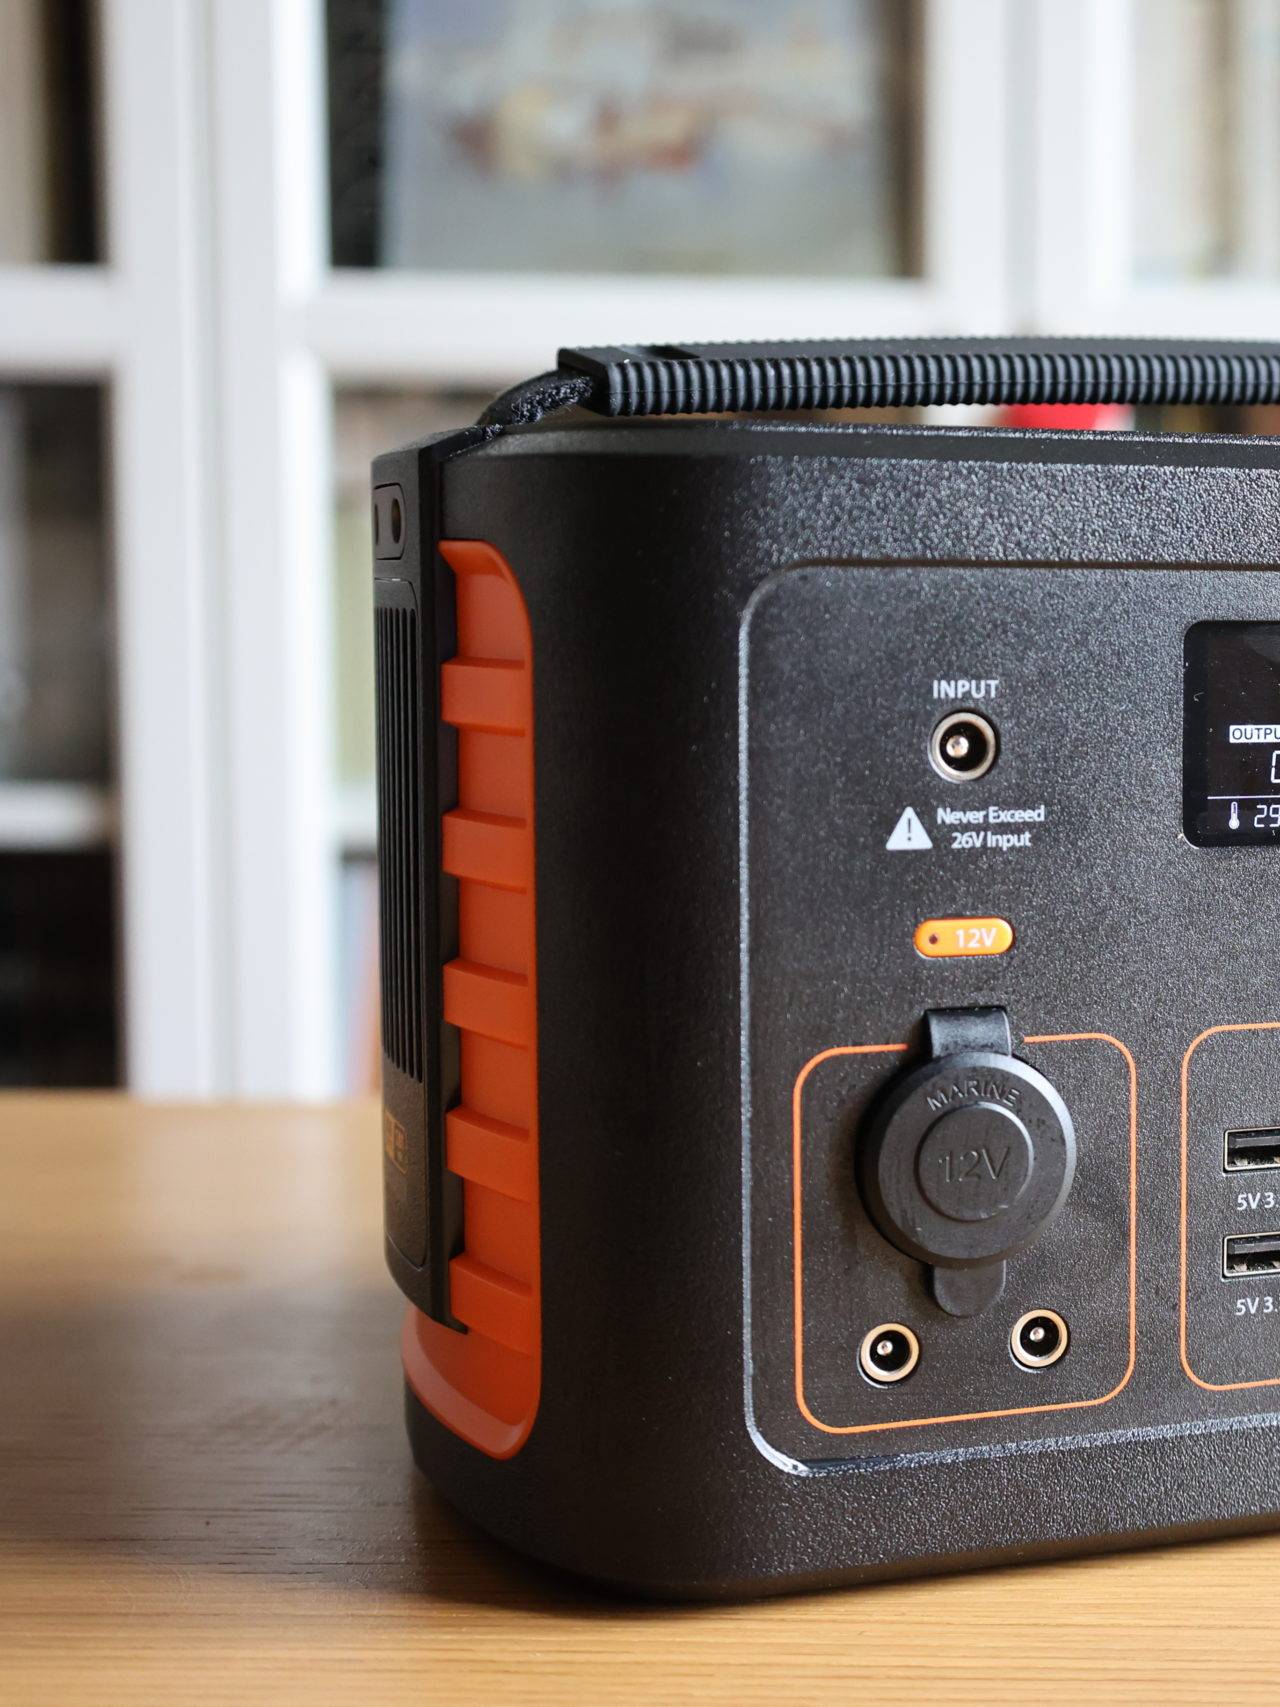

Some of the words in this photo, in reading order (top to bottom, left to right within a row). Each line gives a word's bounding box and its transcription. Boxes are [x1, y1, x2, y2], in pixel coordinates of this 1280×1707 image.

[932, 680, 999, 698] INPUT
[936, 808, 986, 824] Never
[988, 805, 1045, 823] Exceed
[951, 832, 985, 849] 26V
[986, 831, 1031, 850] Input
[955, 927, 997, 948] 12V
[926, 1079, 1020, 1111] MARINE
[938, 1146, 1011, 1183] 12V
[1236, 1193, 1260, 1211] 5V
[1235, 1297, 1259, 1316] 5V
